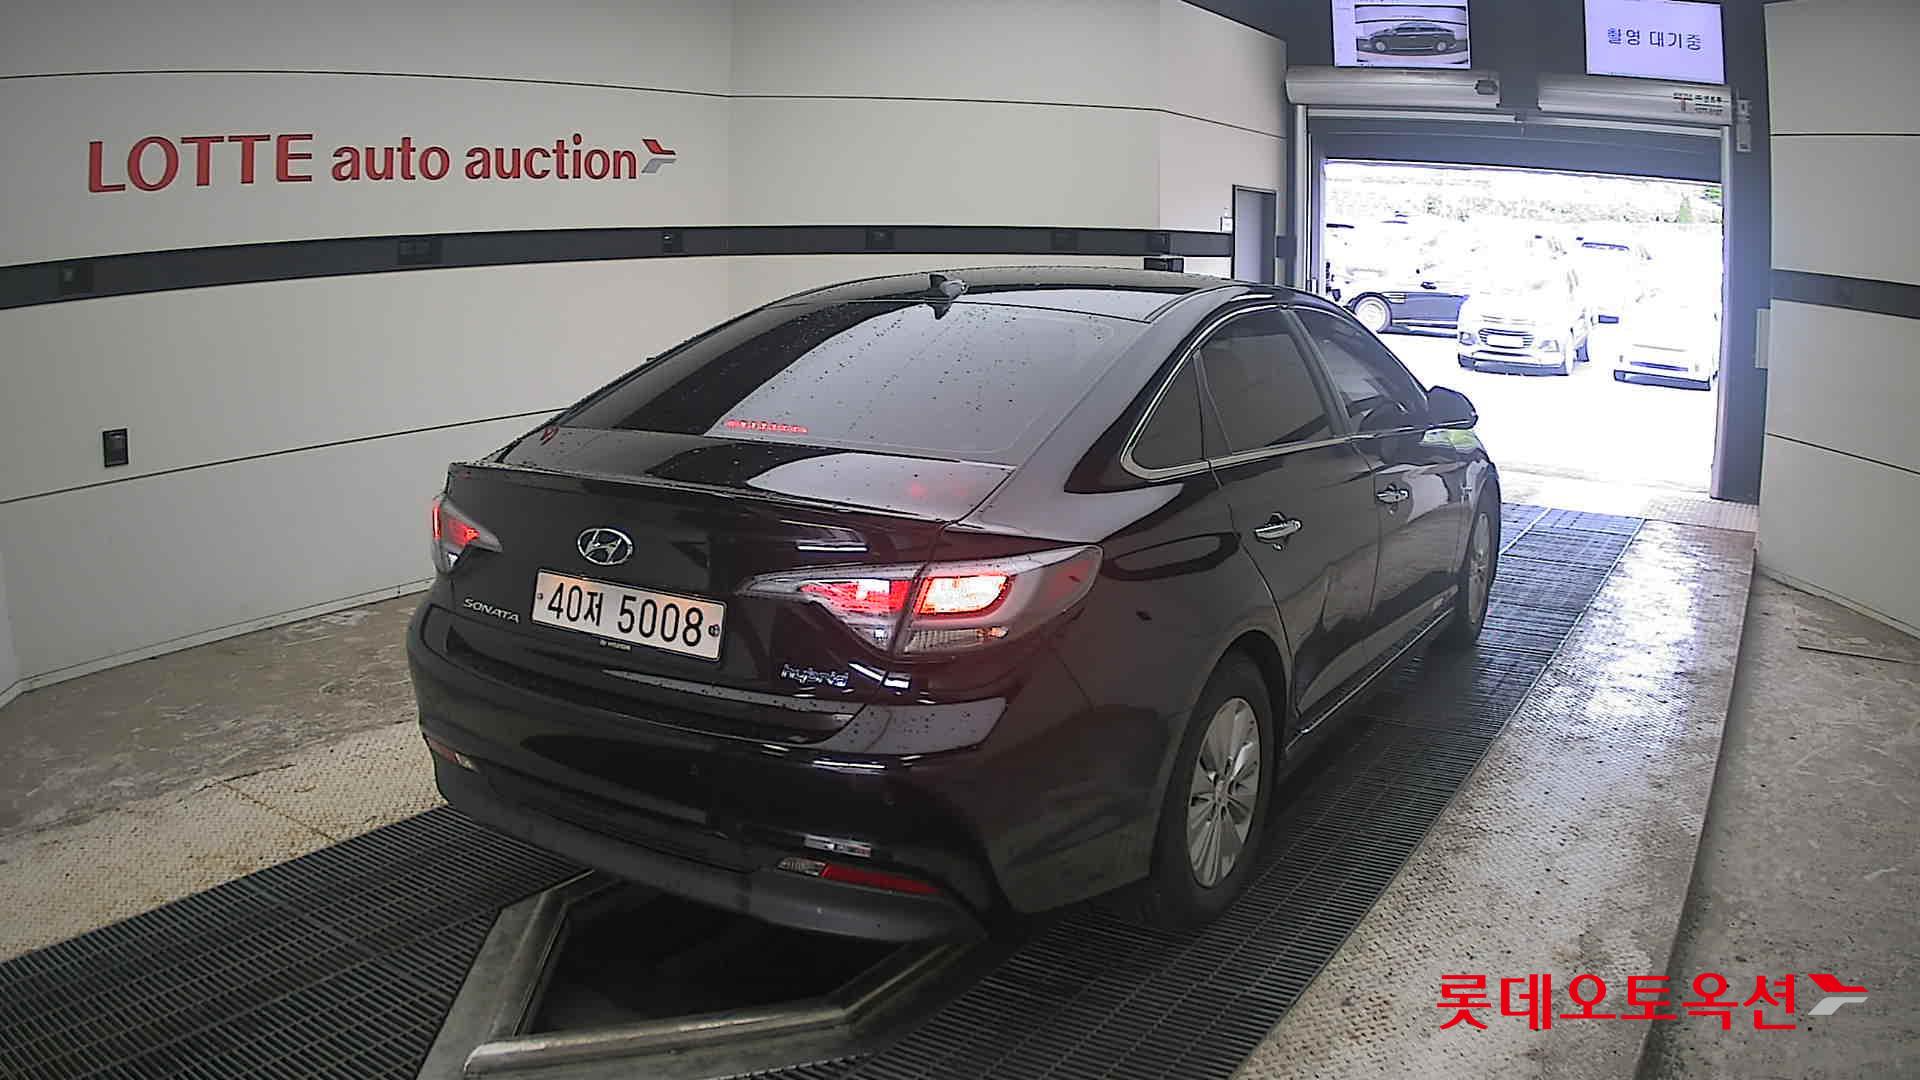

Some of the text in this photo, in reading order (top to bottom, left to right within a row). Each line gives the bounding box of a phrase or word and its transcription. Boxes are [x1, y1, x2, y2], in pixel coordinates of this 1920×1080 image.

[1649, 31, 1701, 50] 대기중
[88, 133, 638, 193] LOTTE auto auction
[463, 598, 519, 624] SONATA
[546, 582, 704, 647] 40저 5008
